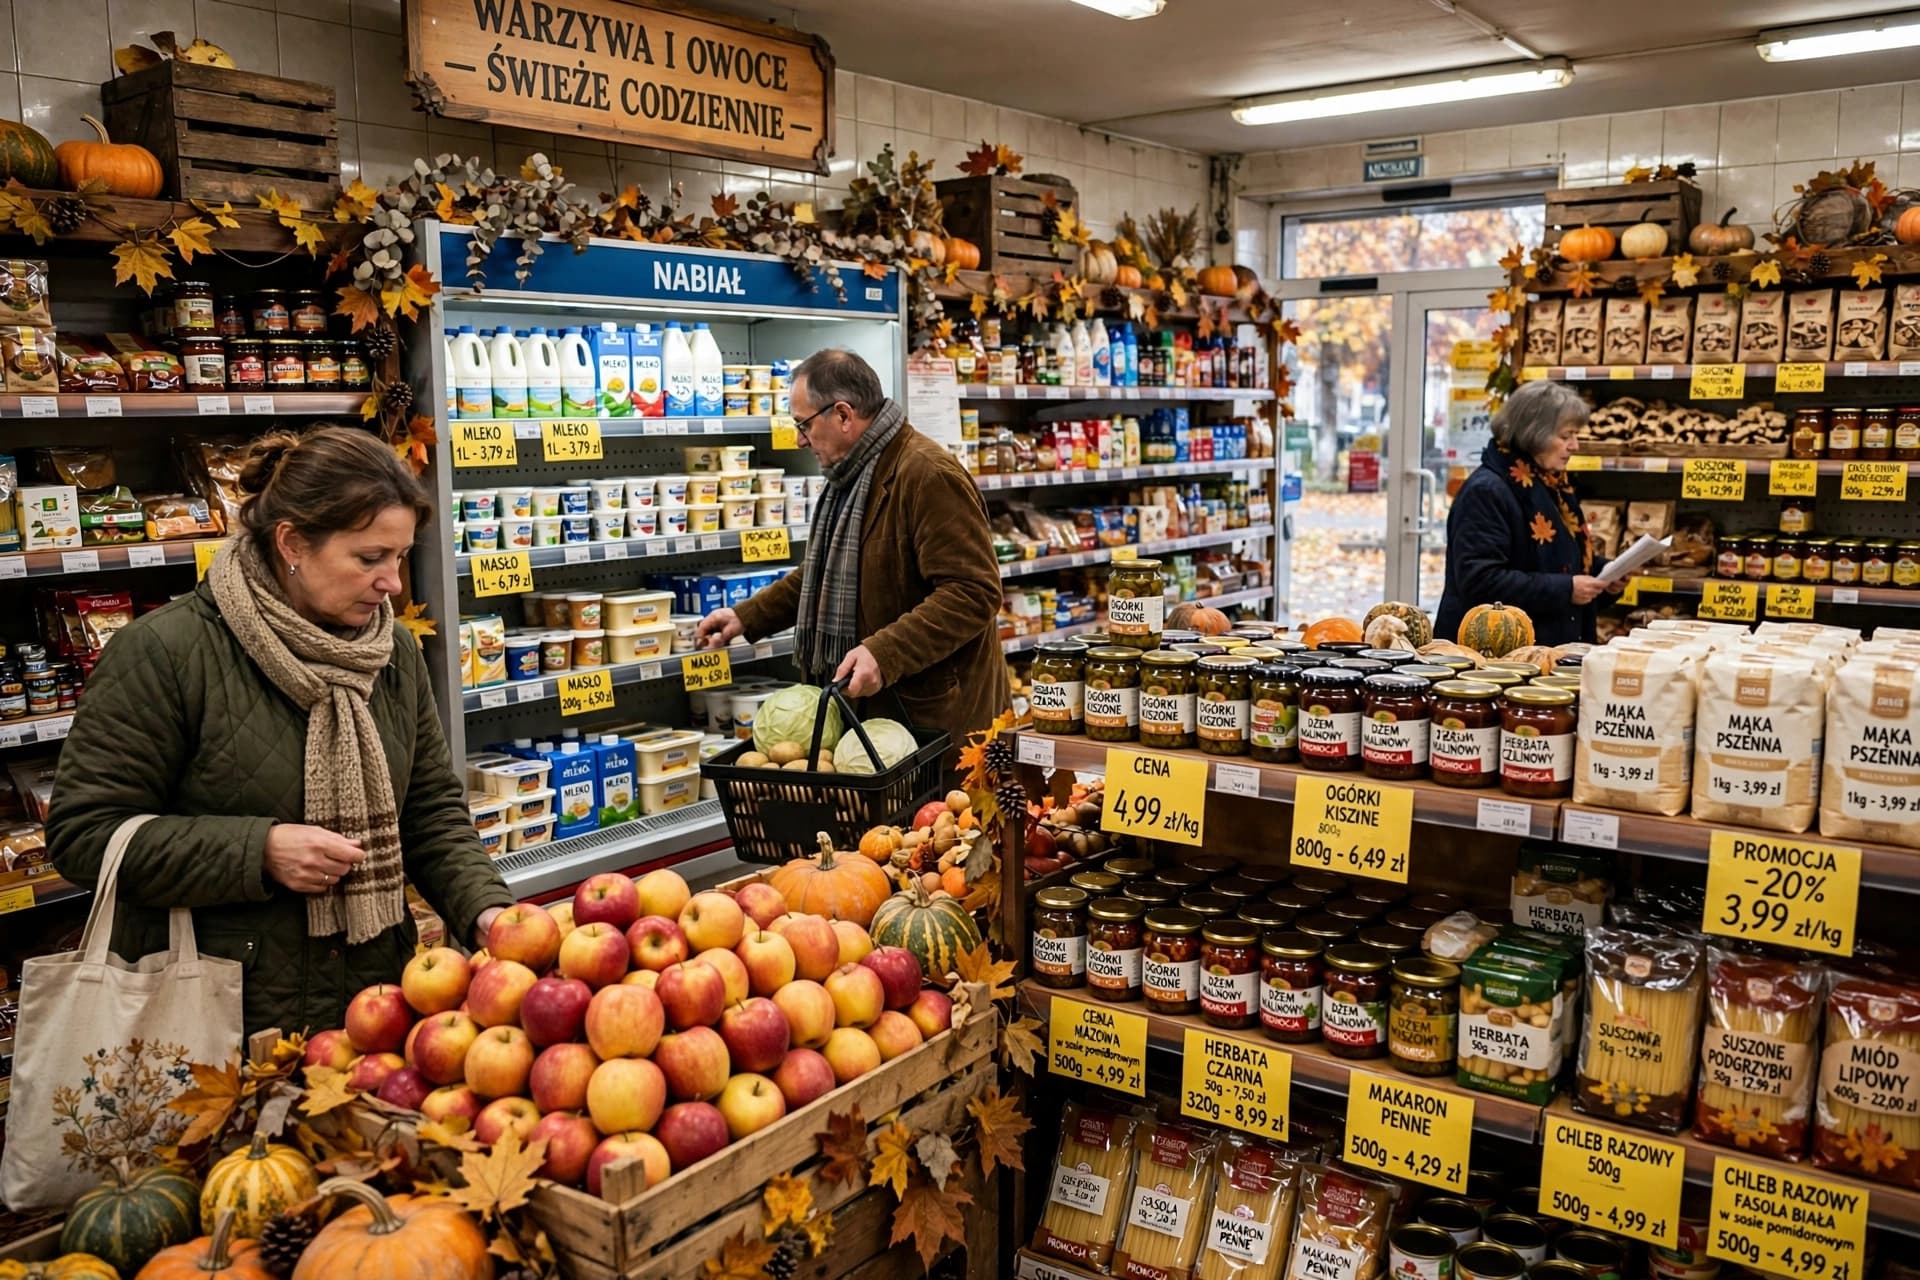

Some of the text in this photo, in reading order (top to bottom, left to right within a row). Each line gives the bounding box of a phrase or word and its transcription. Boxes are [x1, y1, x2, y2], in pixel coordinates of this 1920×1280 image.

[474, 0, 787, 91] WARZYWA I OWOCE
[487, 42, 784, 140] ŚWIEŻE CODZIENNIE
[653, 261, 746, 295] NABIAŁ
[464, 426, 501, 440] MLEKO
[553, 423, 588, 436] MLEKO
[457, 446, 502, 462] 1L 3,79
[548, 441, 589, 456] 1L 3,79
[1694, 461, 1736, 471] SUSZONE
[480, 556, 518, 572] MASŁO
[476, 574, 520, 591] 1L 6,79
[1605, 704, 1645, 723] MĄKA
[1728, 714, 1772, 735] MĄKA
[1595, 720, 1655, 740] PSZENNA
[1863, 726, 1911, 747] MĄKA
[1717, 733, 1782, 753] PSZENNA
[1851, 745, 1920, 766] PSZENNA
[1134, 757, 1170, 778] CENA
[1619, 766, 1640, 781] 3,99
[564, 784, 590, 797] MLEKO
[606, 775, 629, 788] MLEKO
[1743, 780, 1767, 795] 3,99
[1326, 784, 1380, 806] OGÓRKI
[1880, 795, 1906, 811] 3,99
[1113, 789, 1199, 839] 4,99 zł/kg
[1296, 837, 1405, 872] 800g 6,49 zł
[1733, 840, 1836, 872] PROMOCJA
[1529, 905, 1584, 925] HERBATA
[1720, 894, 1842, 948] 3,99 zł/kg
[1089, 950, 1121, 964] OGÓRKI
[1469, 1024, 1529, 1048] HERBATA
[1722, 1034, 1785, 1060] SUSZONE
[1205, 1038, 1268, 1069] HERBATA
[1472, 1040, 1517, 1058] 50g 7,50
[1852, 1045, 1899, 1069] MIÓD
[1055, 1054, 1141, 1088] 500g 4,99 zł
[1207, 1060, 1263, 1088] CZARNA
[1708, 1049, 1792, 1081] PODGRZYBKI
[1714, 1070, 1731, 1087] 50g
[1839, 1064, 1909, 1094] LIPOWY
[1205, 1079, 1223, 1096] 50g
[1234, 1086, 1254, 1101] 7,50
[1369, 1083, 1447, 1118] MAKARON
[1834, 1084, 1903, 1110] 400g 22,00
[1186, 1091, 1284, 1132] 320g 8,99 zł
[1381, 1107, 1431, 1136] PENNE
[1556, 1126, 1674, 1168] CHLEB RAZOWY
[1351, 1135, 1461, 1184] 500g 4,29 zł
[1588, 1155, 1621, 1183] 500g
[1725, 1168, 1859, 1214] CHLEB RAZOWY
[1553, 1191, 1666, 1237] 500g 4,99 zł
[1735, 1193, 1835, 1229] FASOLA BIAŁA
[1216, 1219, 1263, 1241] MAKARON
[1220, 1232, 1252, 1250] PENNE
[1720, 1210, 1855, 1251] w sosie pomidorowym
[1303, 1246, 1351, 1269] MAKARON
[1718, 1230, 1849, 1280] 500g 4,99 zł
[1306, 1261, 1339, 1279] PENNE
